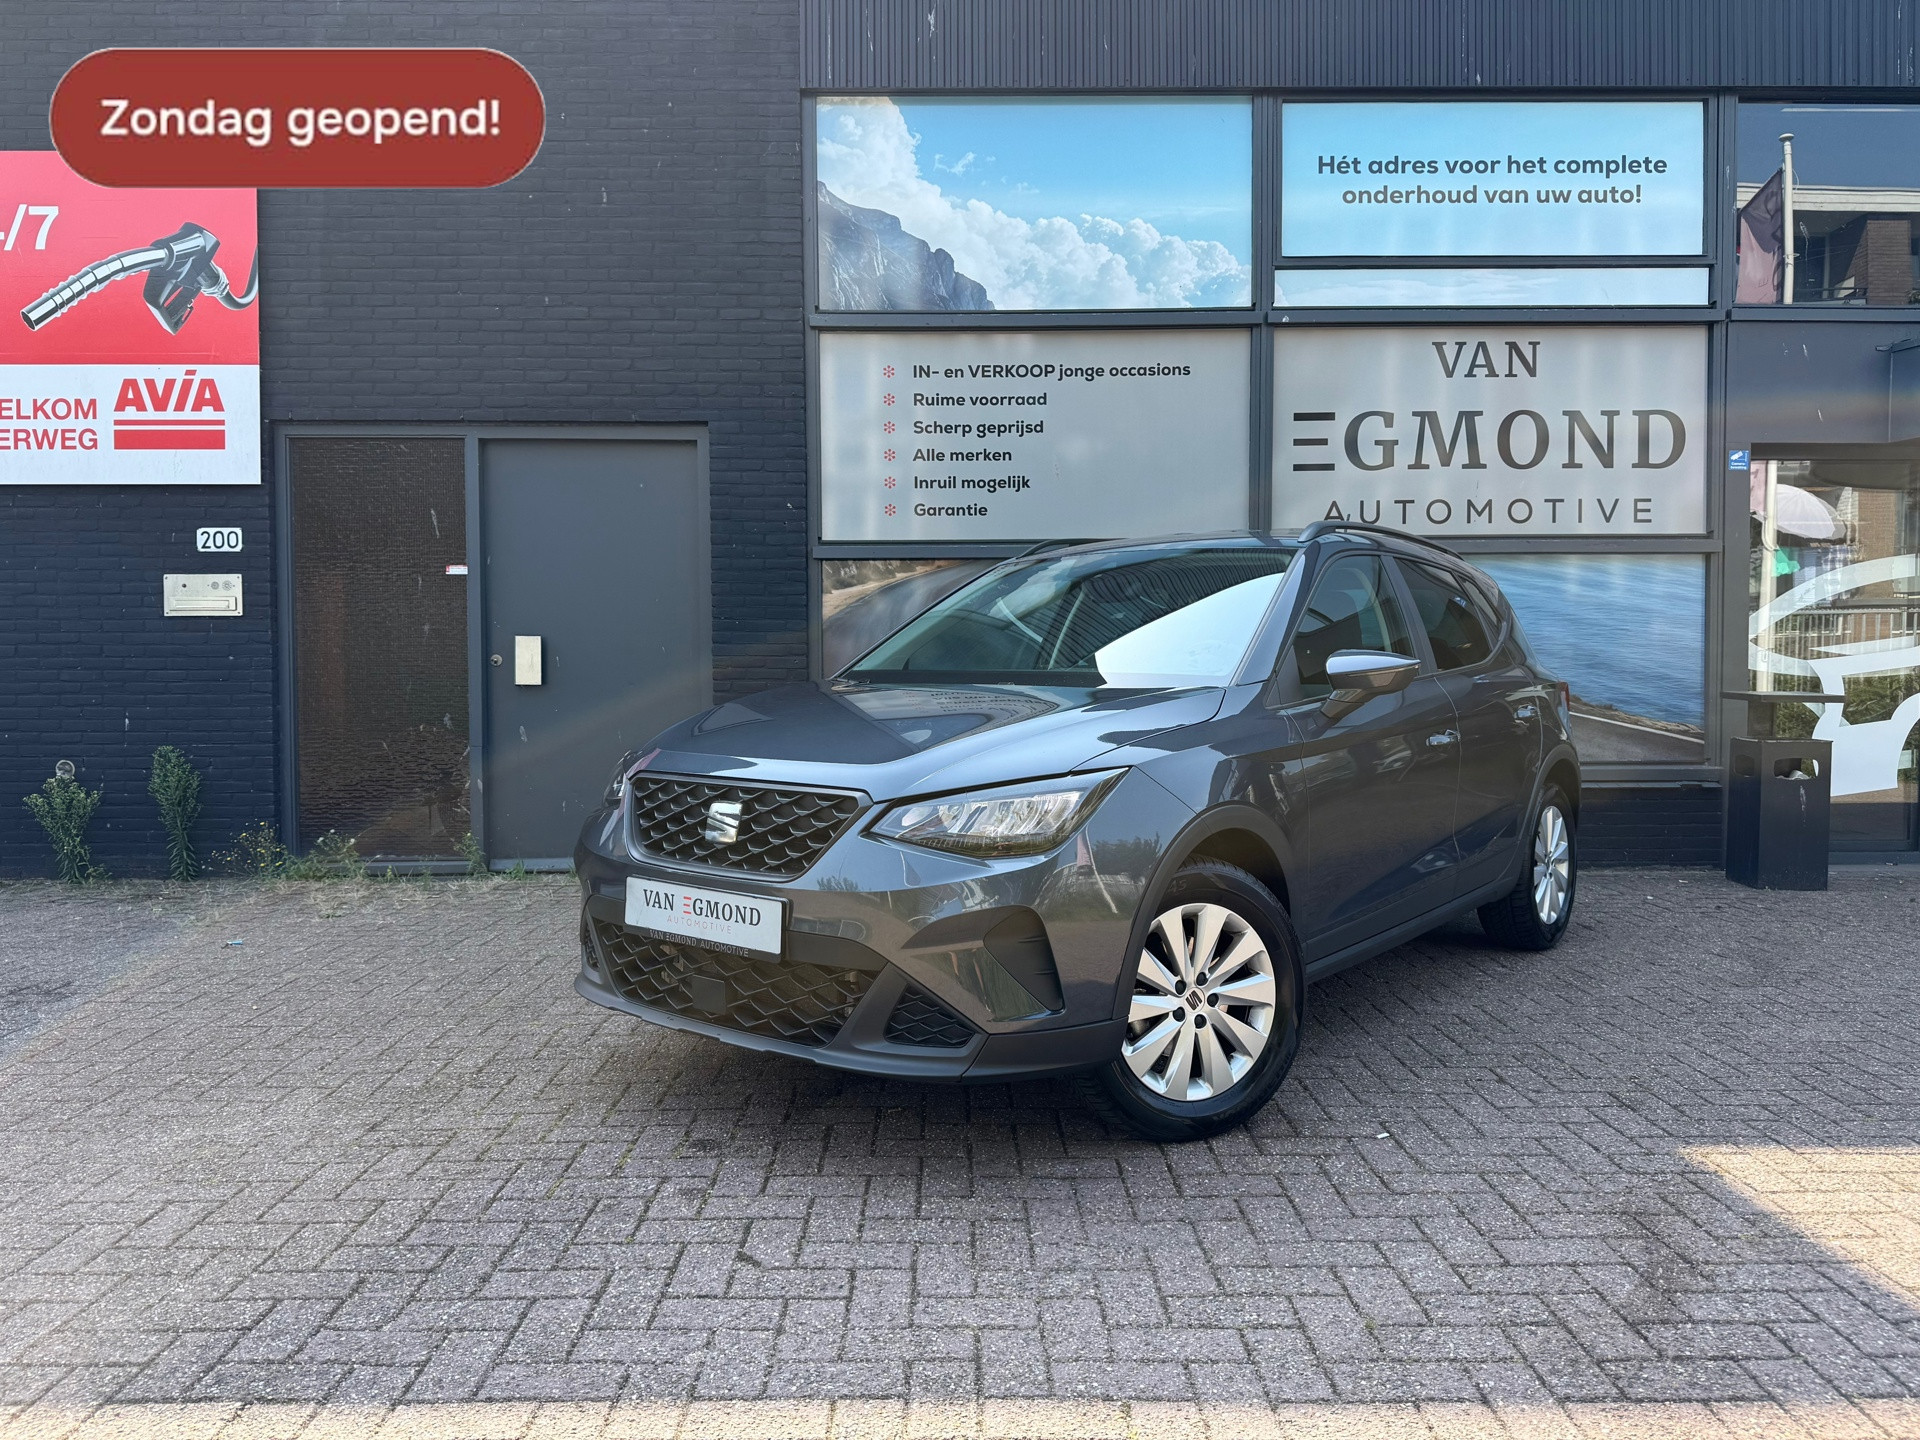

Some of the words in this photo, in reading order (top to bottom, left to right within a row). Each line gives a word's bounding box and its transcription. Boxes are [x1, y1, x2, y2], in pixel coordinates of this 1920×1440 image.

[1318, 155, 1362, 174] Hét
[1368, 155, 1439, 174] adres
[1445, 160, 1501, 174] voor
[1507, 155, 1548, 174] het
[1553, 155, 1668, 179] complete
[1342, 184, 1478, 204] onderhoud
[1484, 189, 1529, 204] van
[1536, 189, 1573, 204] uw
[1578, 184, 1642, 204] auto!
[0, 203, 59, 251] /7
[1431, 340, 1541, 379] VAN
[913, 365, 940, 379] IN-
[944, 368, 964, 379] en
[968, 364, 1056, 379] VERKOOP
[1058, 363, 1105, 382] jonge
[1109, 363, 1191, 377] occasions
[913, 393, 966, 407] Ruime
[970, 392, 1047, 407] voorraad
[913, 420, 972, 438] Scherp
[977, 420, 1044, 438] geprijsd
[1293, 410, 1686, 472] EGMOND
[913, 448, 946, 462] Alle
[950, 448, 1012, 462] merken
[914, 475, 957, 489] Inruil
[961, 475, 1031, 493] mogelijk
[914, 502, 988, 517] Garantie
[1324, 498, 1653, 525] AUTOMOTIVE
[200, 530, 239, 550] 200
[643, 889, 675, 911] VAN
[683, 896, 761, 926] EGMOND
[667, 915, 732, 934] AUTOMOTIVE
[649, 929, 664, 941] VAN
[666, 933, 697, 947] EGMOND
[700, 940, 749, 958] AUTOMOTIVE
